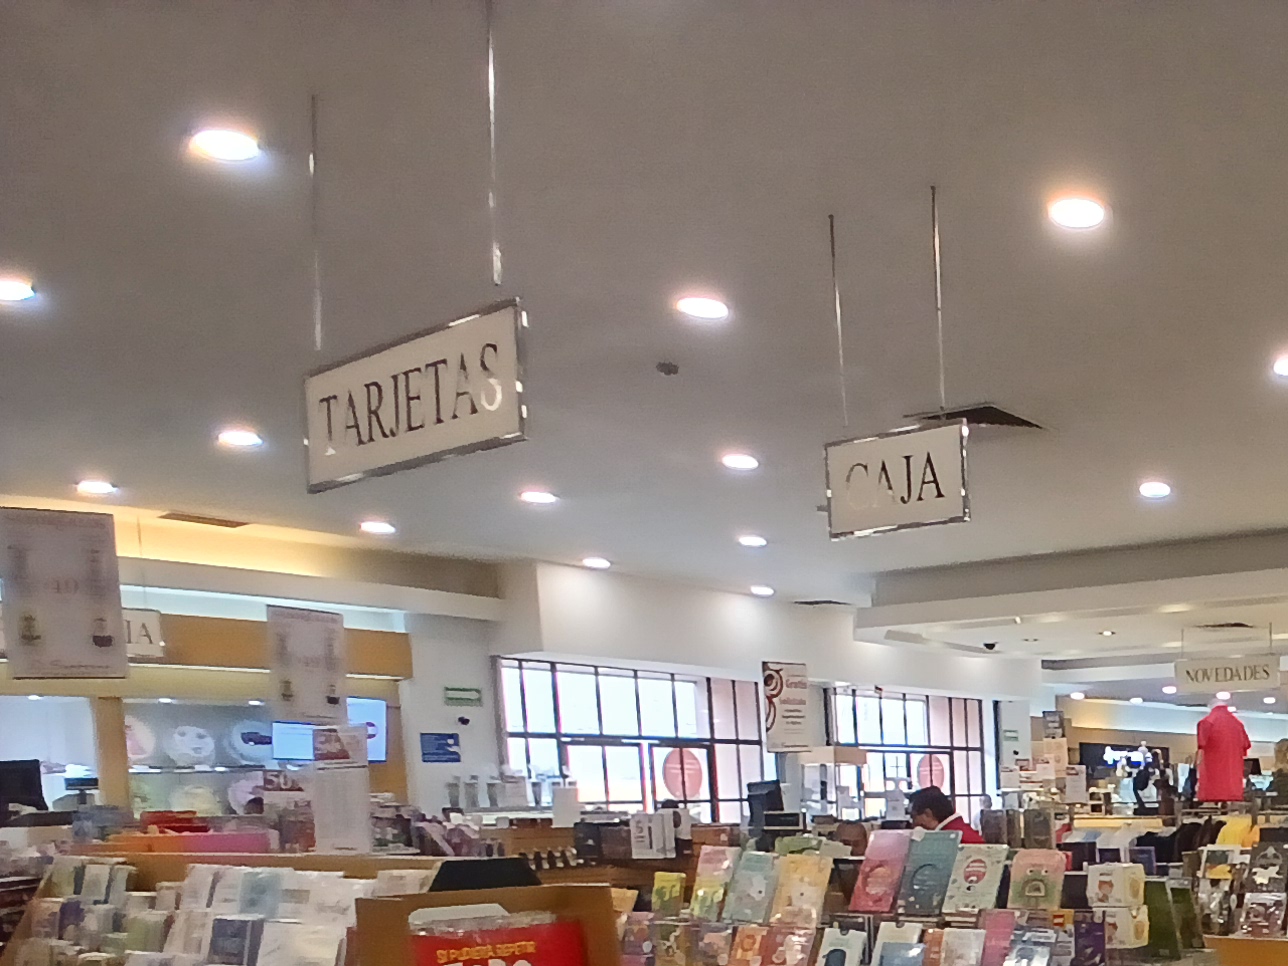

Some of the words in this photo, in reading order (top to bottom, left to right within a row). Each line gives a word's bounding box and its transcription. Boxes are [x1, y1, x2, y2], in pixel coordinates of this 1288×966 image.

[319, 343, 502, 456] TARJETAS
[846, 451, 945, 510] CAJA
[1185, 663, 1270, 684] NOVEDADES
